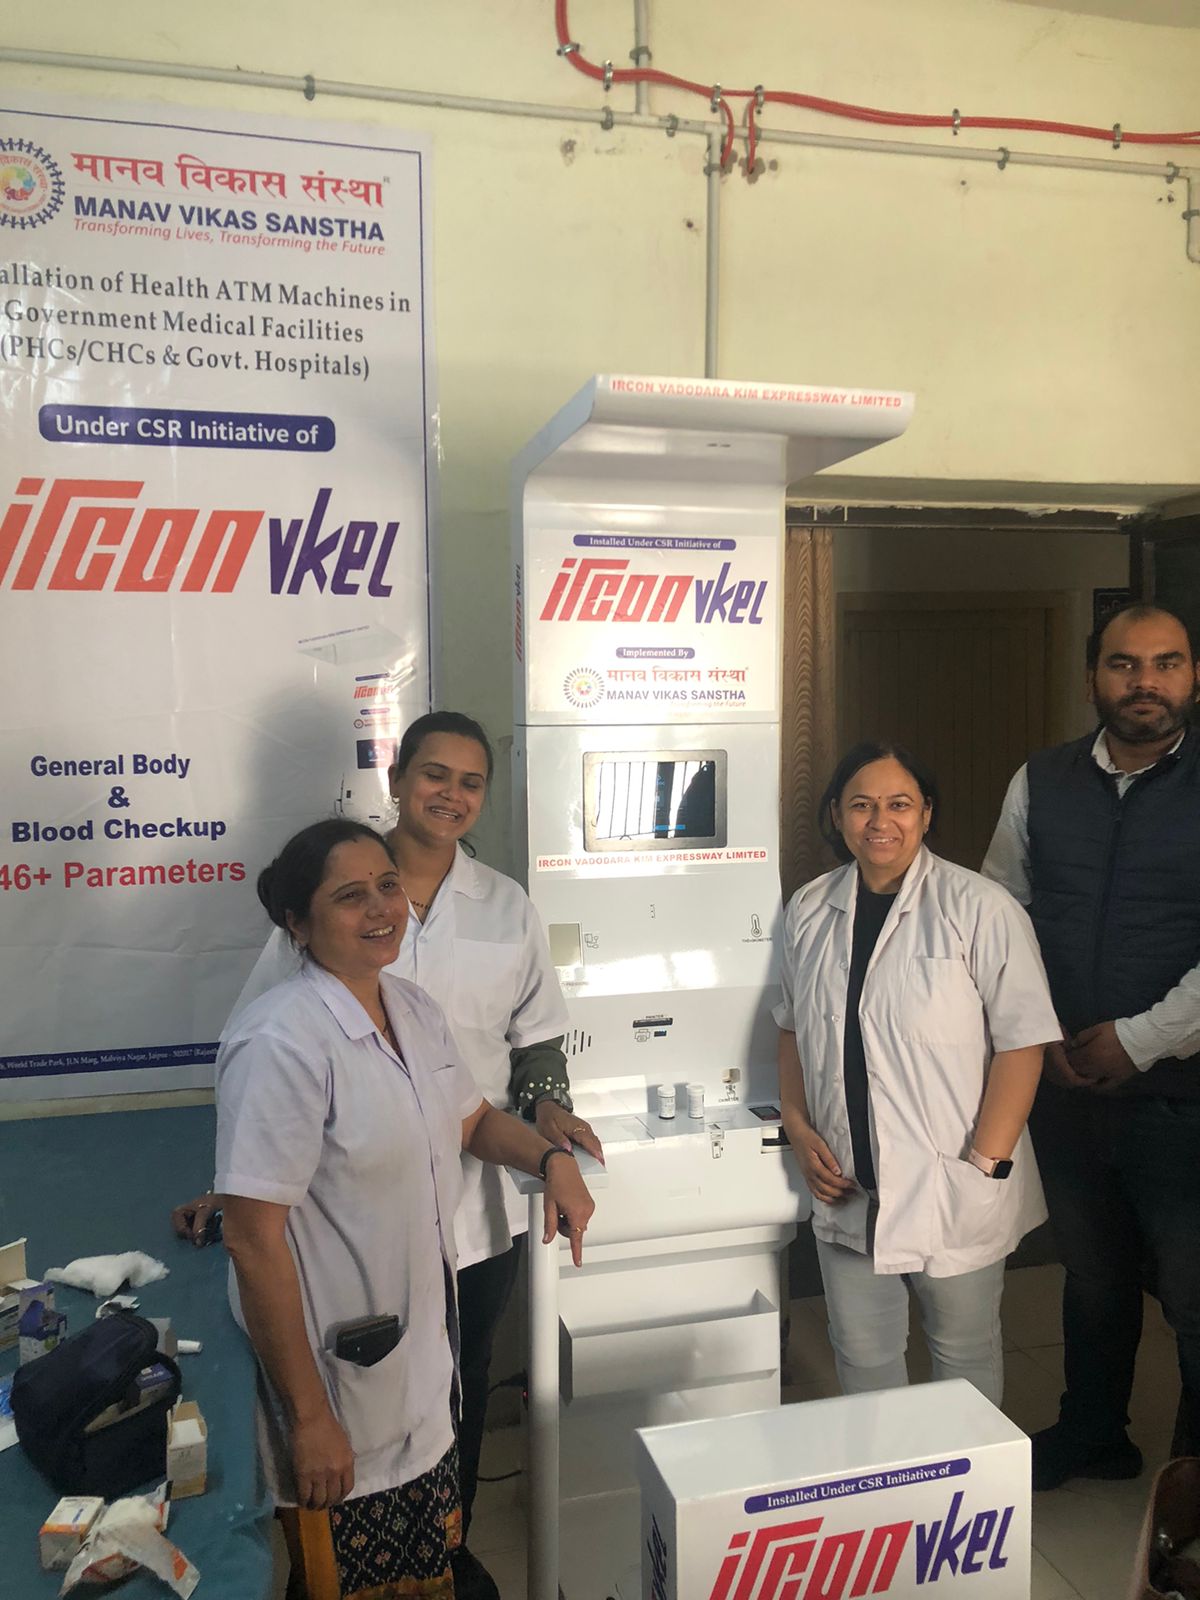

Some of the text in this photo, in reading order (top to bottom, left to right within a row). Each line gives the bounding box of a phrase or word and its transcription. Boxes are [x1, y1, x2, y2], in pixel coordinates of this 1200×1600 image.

[71, 152, 384, 208] मानव विकास संस्था
[74, 195, 172, 223] MANAV
[179, 204, 258, 231] VIKAS
[266, 211, 385, 242] SANSTHA
[73, 218, 386, 256] Transforming Lives, Transforming the Future
[100, 271, 125, 293] of
[130, 272, 210, 299] Health
[215, 279, 272, 303] ATM
[278, 283, 385, 312] Machines
[389, 291, 411, 313] in
[4, 299, 364, 343] Government Medical Facilities
[0, 334, 371, 382] (PHCs/CHCs & Govt. Hospitals)
[611, 379, 902, 407] IRCON VADODARA KIM EXPRESSWAY LIMITED
[56, 414, 320, 445] Under CSR Initiative of
[0, 477, 400, 598] ircon vkel
[589, 537, 722, 549] Installed Under CSR Initiative of
[539, 557, 768, 624] ircon vkel
[622, 648, 689, 659] Implemented By
[606, 665, 746, 683] मानव विकास संस्था
[606, 689, 746, 701] MANAV VIKAS SANSTHA
[30, 753, 191, 779] General Body
[107, 786, 131, 809] &
[11, 817, 227, 843] Blood Checkup
[0, 859, 247, 891] 46+ Parameters
[538, 859, 572, 868] IRCON
[575, 856, 631, 866] VADODARA
[656, 852, 724, 862] EXPRESSWAY
[726, 850, 766, 860] LIMITED
[767, 1463, 951, 1508] Installed Under CSR Initiative of
[704, 1491, 1015, 1600] ircon vkel
